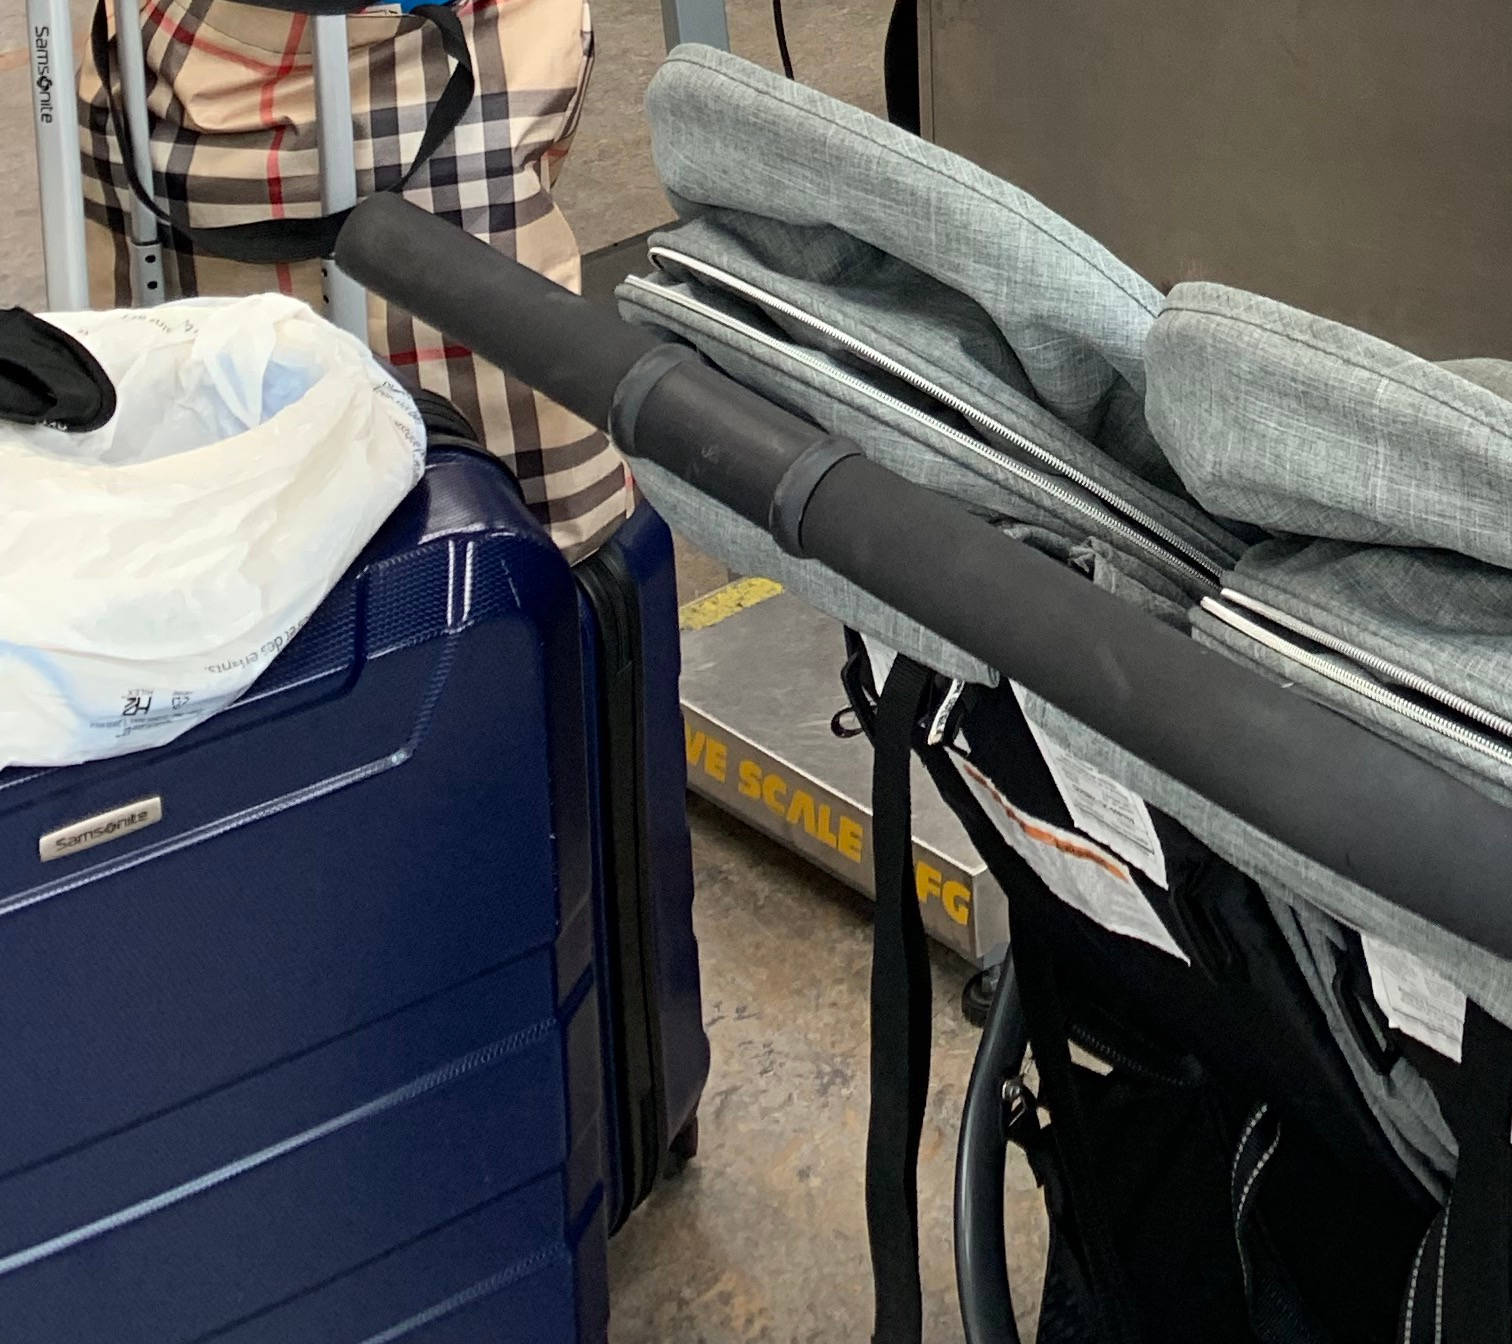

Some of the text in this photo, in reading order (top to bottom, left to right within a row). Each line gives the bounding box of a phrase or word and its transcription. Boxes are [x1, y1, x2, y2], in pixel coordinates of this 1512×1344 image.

[34, 25, 53, 123] Samsonite
[55, 811, 148, 852] Samsonite
[737, 759, 863, 865] SCALE
